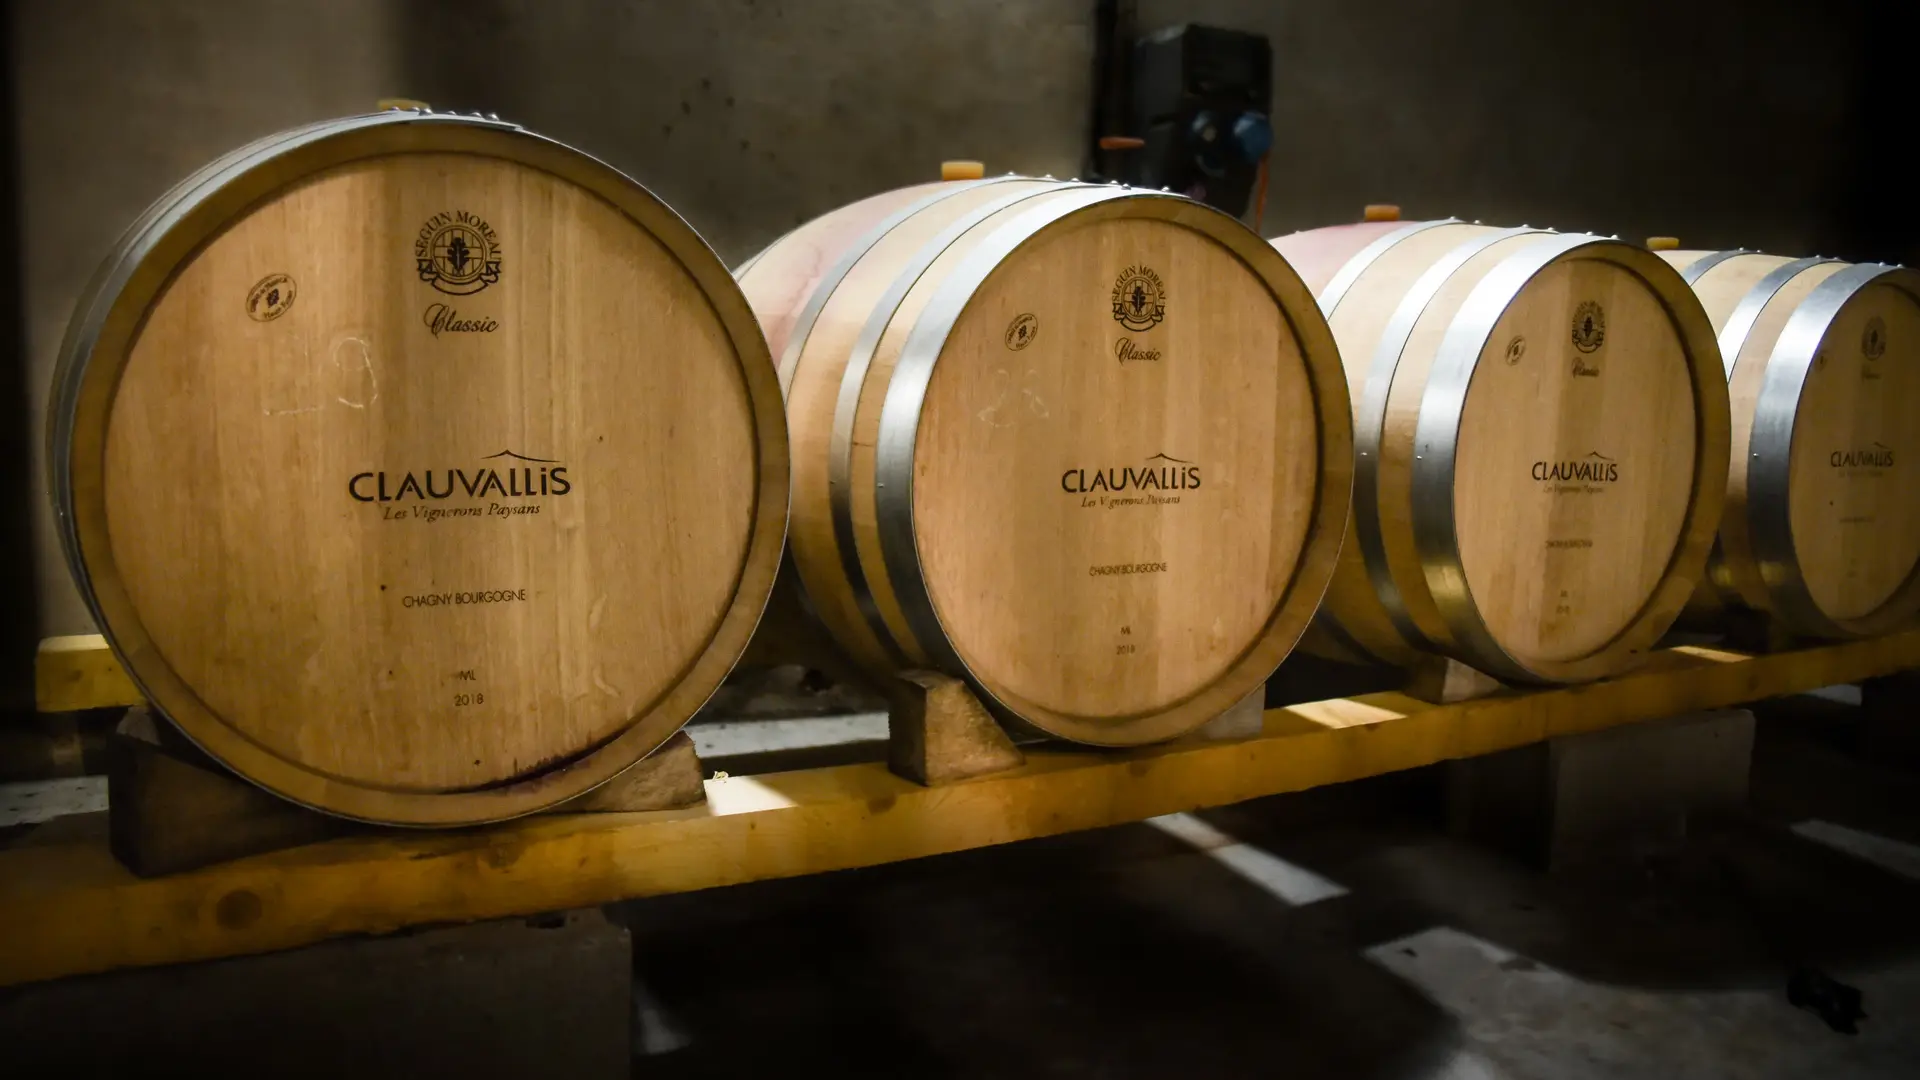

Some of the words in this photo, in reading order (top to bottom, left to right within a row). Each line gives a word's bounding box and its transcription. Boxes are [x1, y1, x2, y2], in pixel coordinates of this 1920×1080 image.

[415, 211, 452, 258] SEGUIN
[423, 303, 500, 340] Classic
[1115, 337, 1161, 366] Classic
[384, 506, 408, 520] Les
[412, 505, 482, 522] Vignerons
[488, 502, 540, 519] Paysans
[1081, 496, 1096, 508] Les
[402, 593, 452, 608] CHAGNY
[455, 589, 526, 604] BOURGOGNE
[453, 693, 485, 706] 2018
